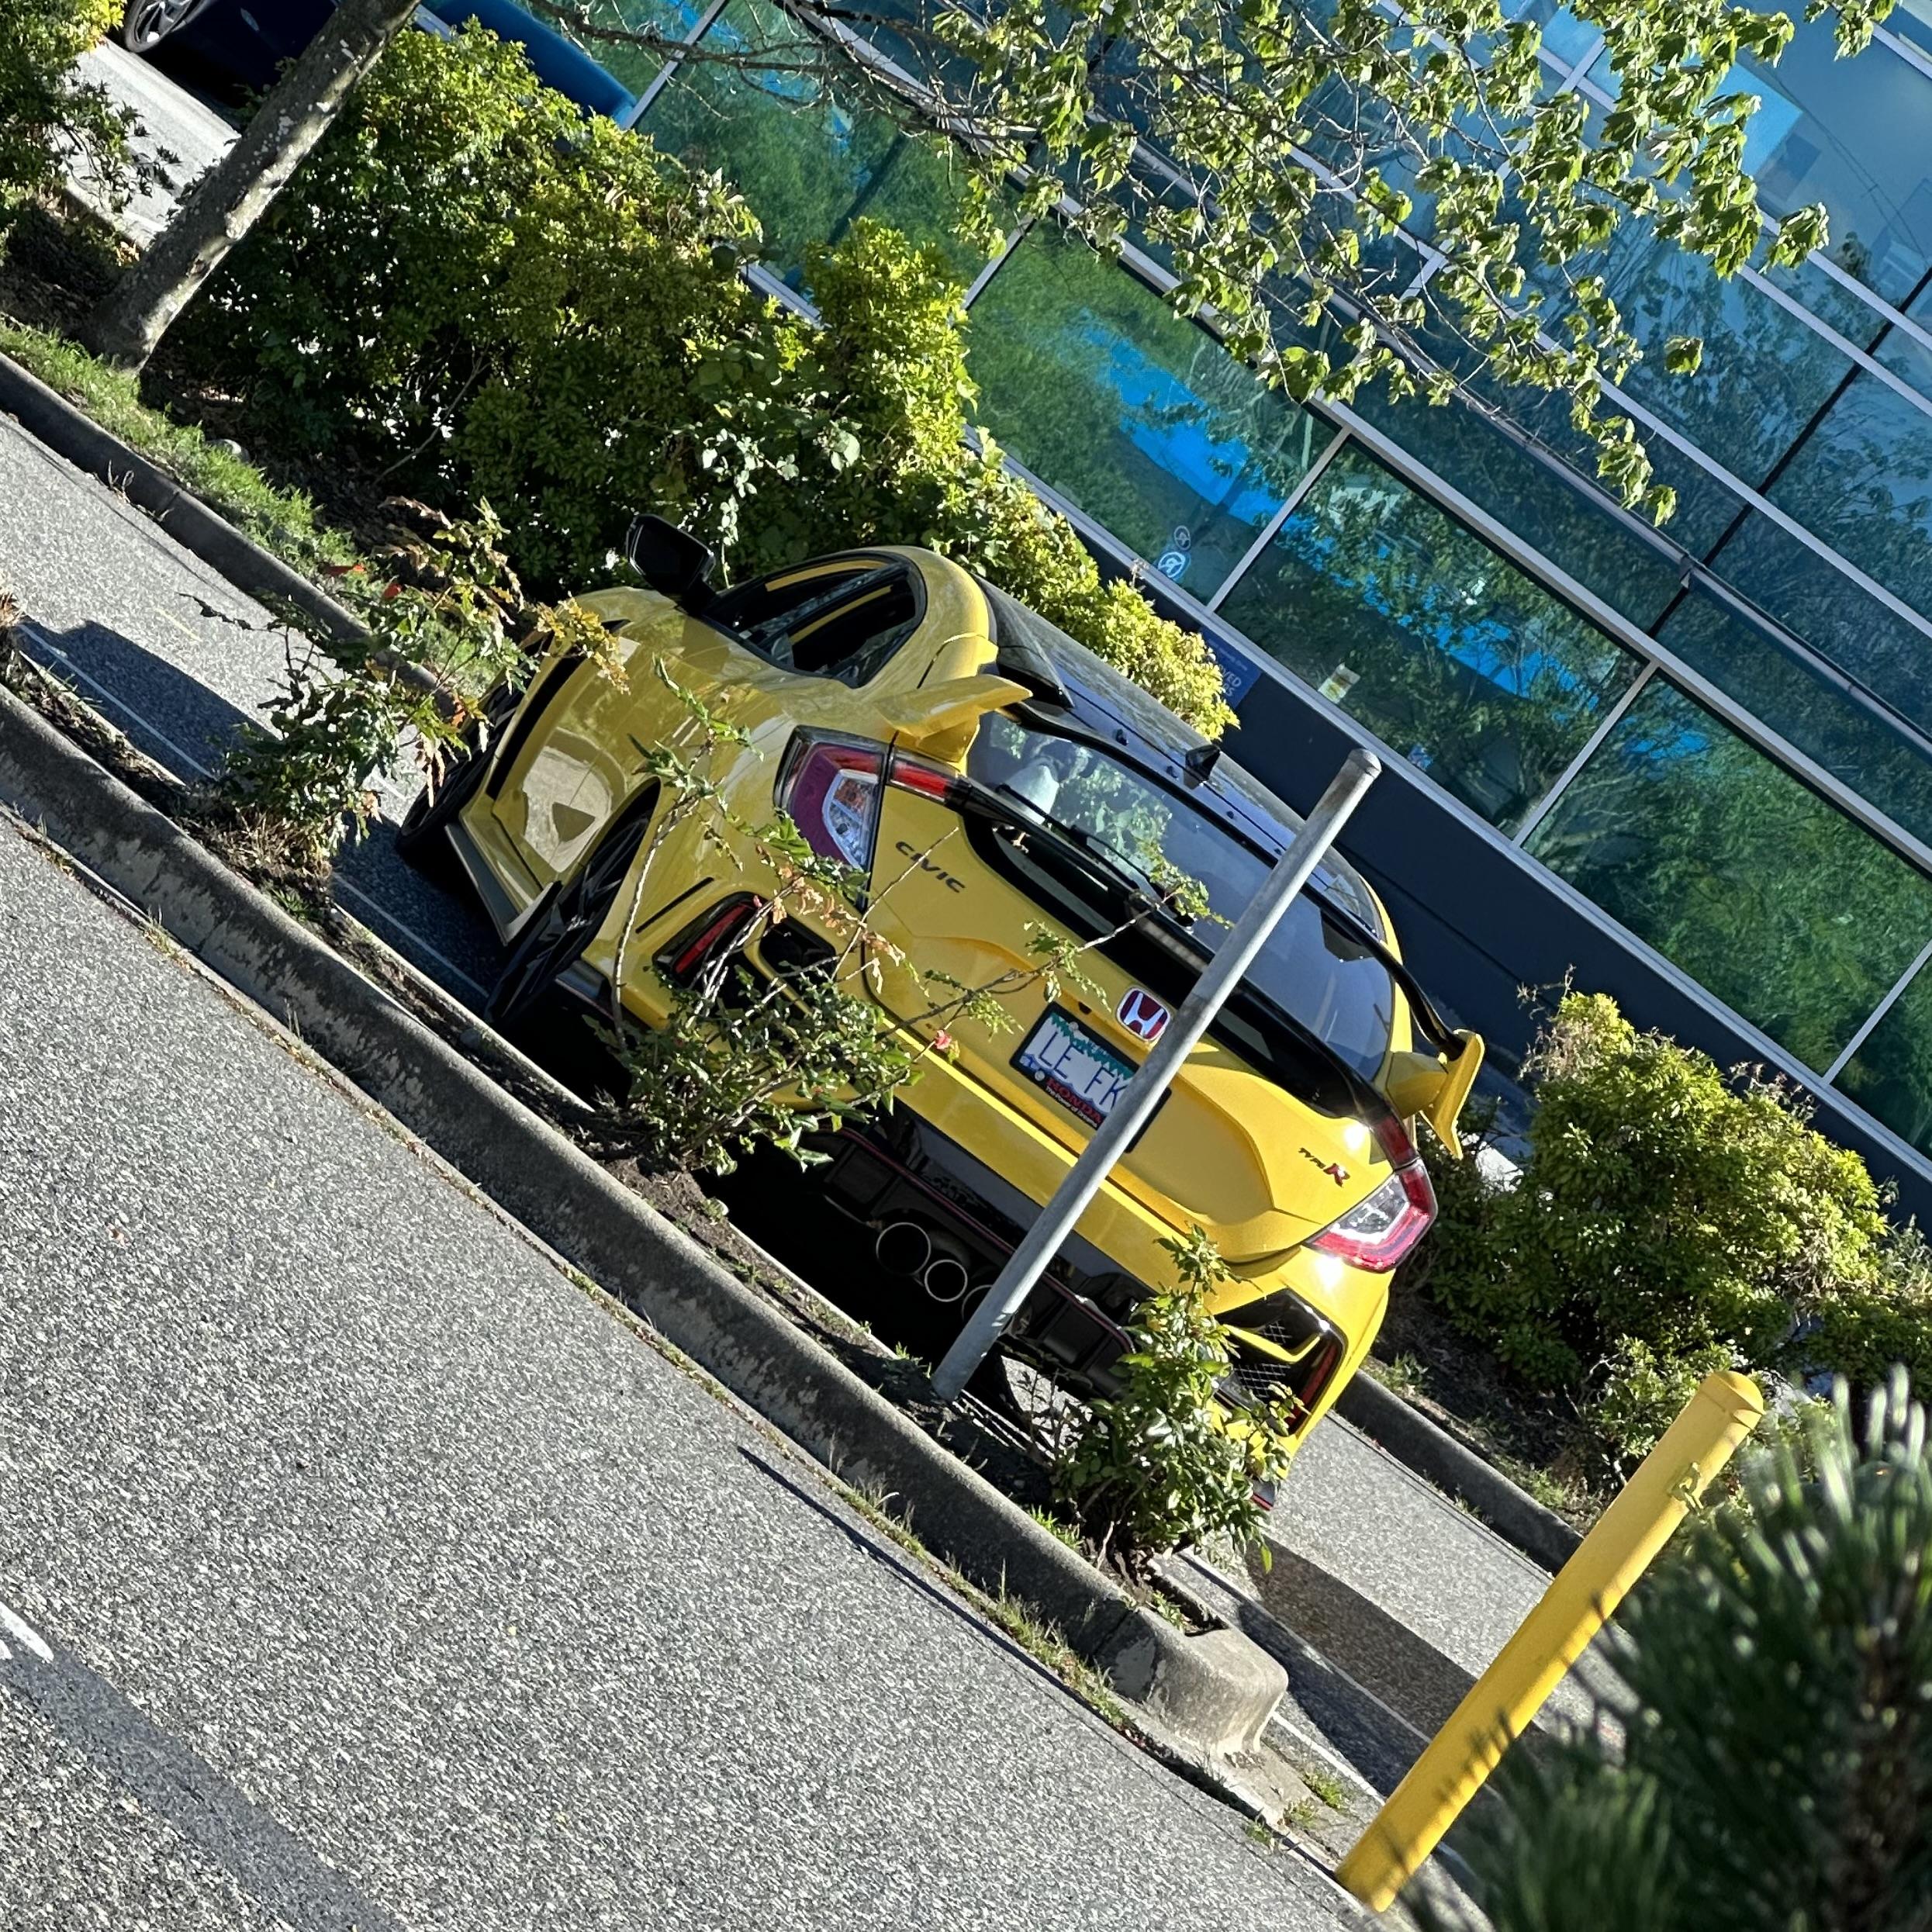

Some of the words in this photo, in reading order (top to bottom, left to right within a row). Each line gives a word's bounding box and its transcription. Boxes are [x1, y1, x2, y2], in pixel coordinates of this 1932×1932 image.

[896, 842, 966, 893] CIVIC
[1039, 1032, 1084, 1079] LE
[1045, 1077, 1103, 1124] HONDA
[1323, 1163, 1350, 1187] R
